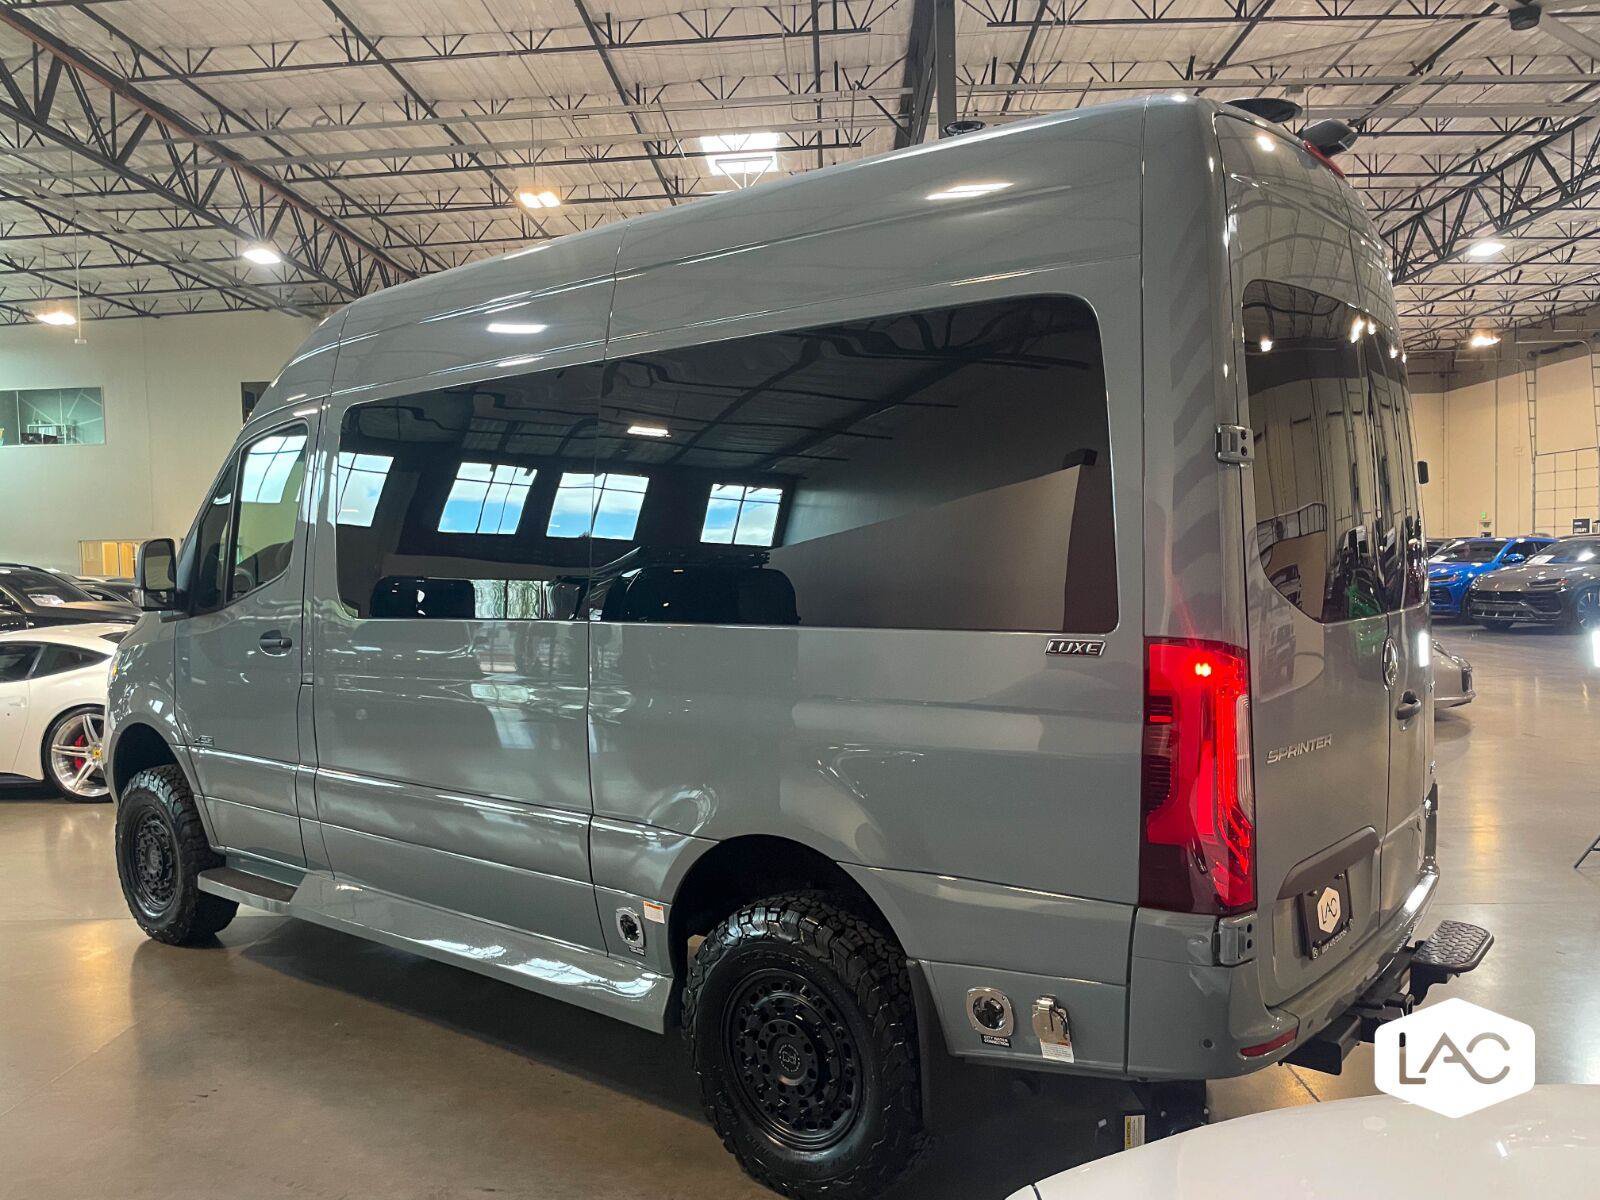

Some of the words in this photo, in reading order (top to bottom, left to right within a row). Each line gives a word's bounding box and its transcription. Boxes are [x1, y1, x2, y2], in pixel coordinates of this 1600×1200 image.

[1047, 641, 1101, 655] LUXE
[1266, 734, 1332, 764] SPRINTER
[1320, 897, 1338, 925] LAC
